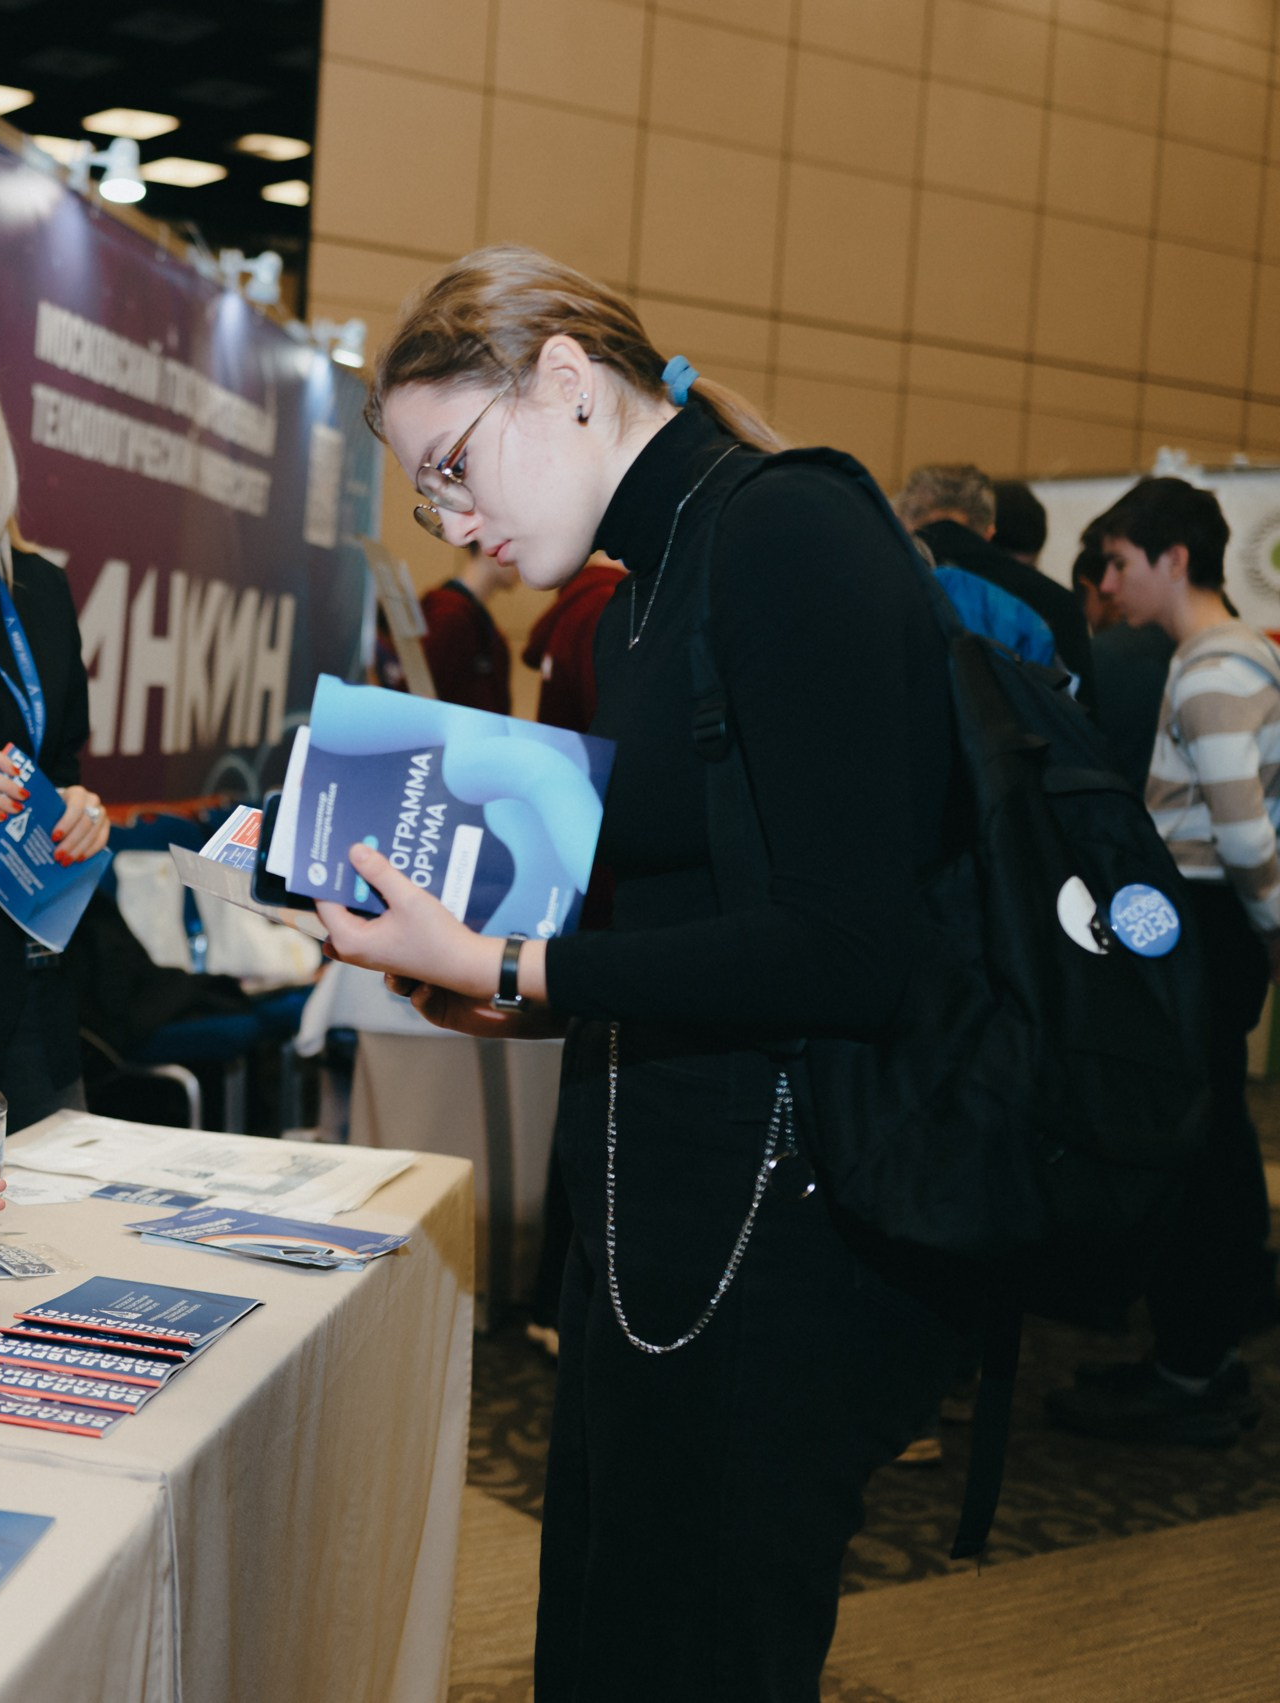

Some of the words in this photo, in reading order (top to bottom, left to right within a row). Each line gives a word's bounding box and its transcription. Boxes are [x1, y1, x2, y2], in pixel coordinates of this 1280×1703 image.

[45, 548, 296, 757] АНКИН
[389, 752, 433, 871] ОГРАММА
[410, 801, 448, 888] ОРУМА
[1124, 905, 1179, 949] 2030
[29, 1307, 201, 1339] СПЕЦИАЛИТЕТ
